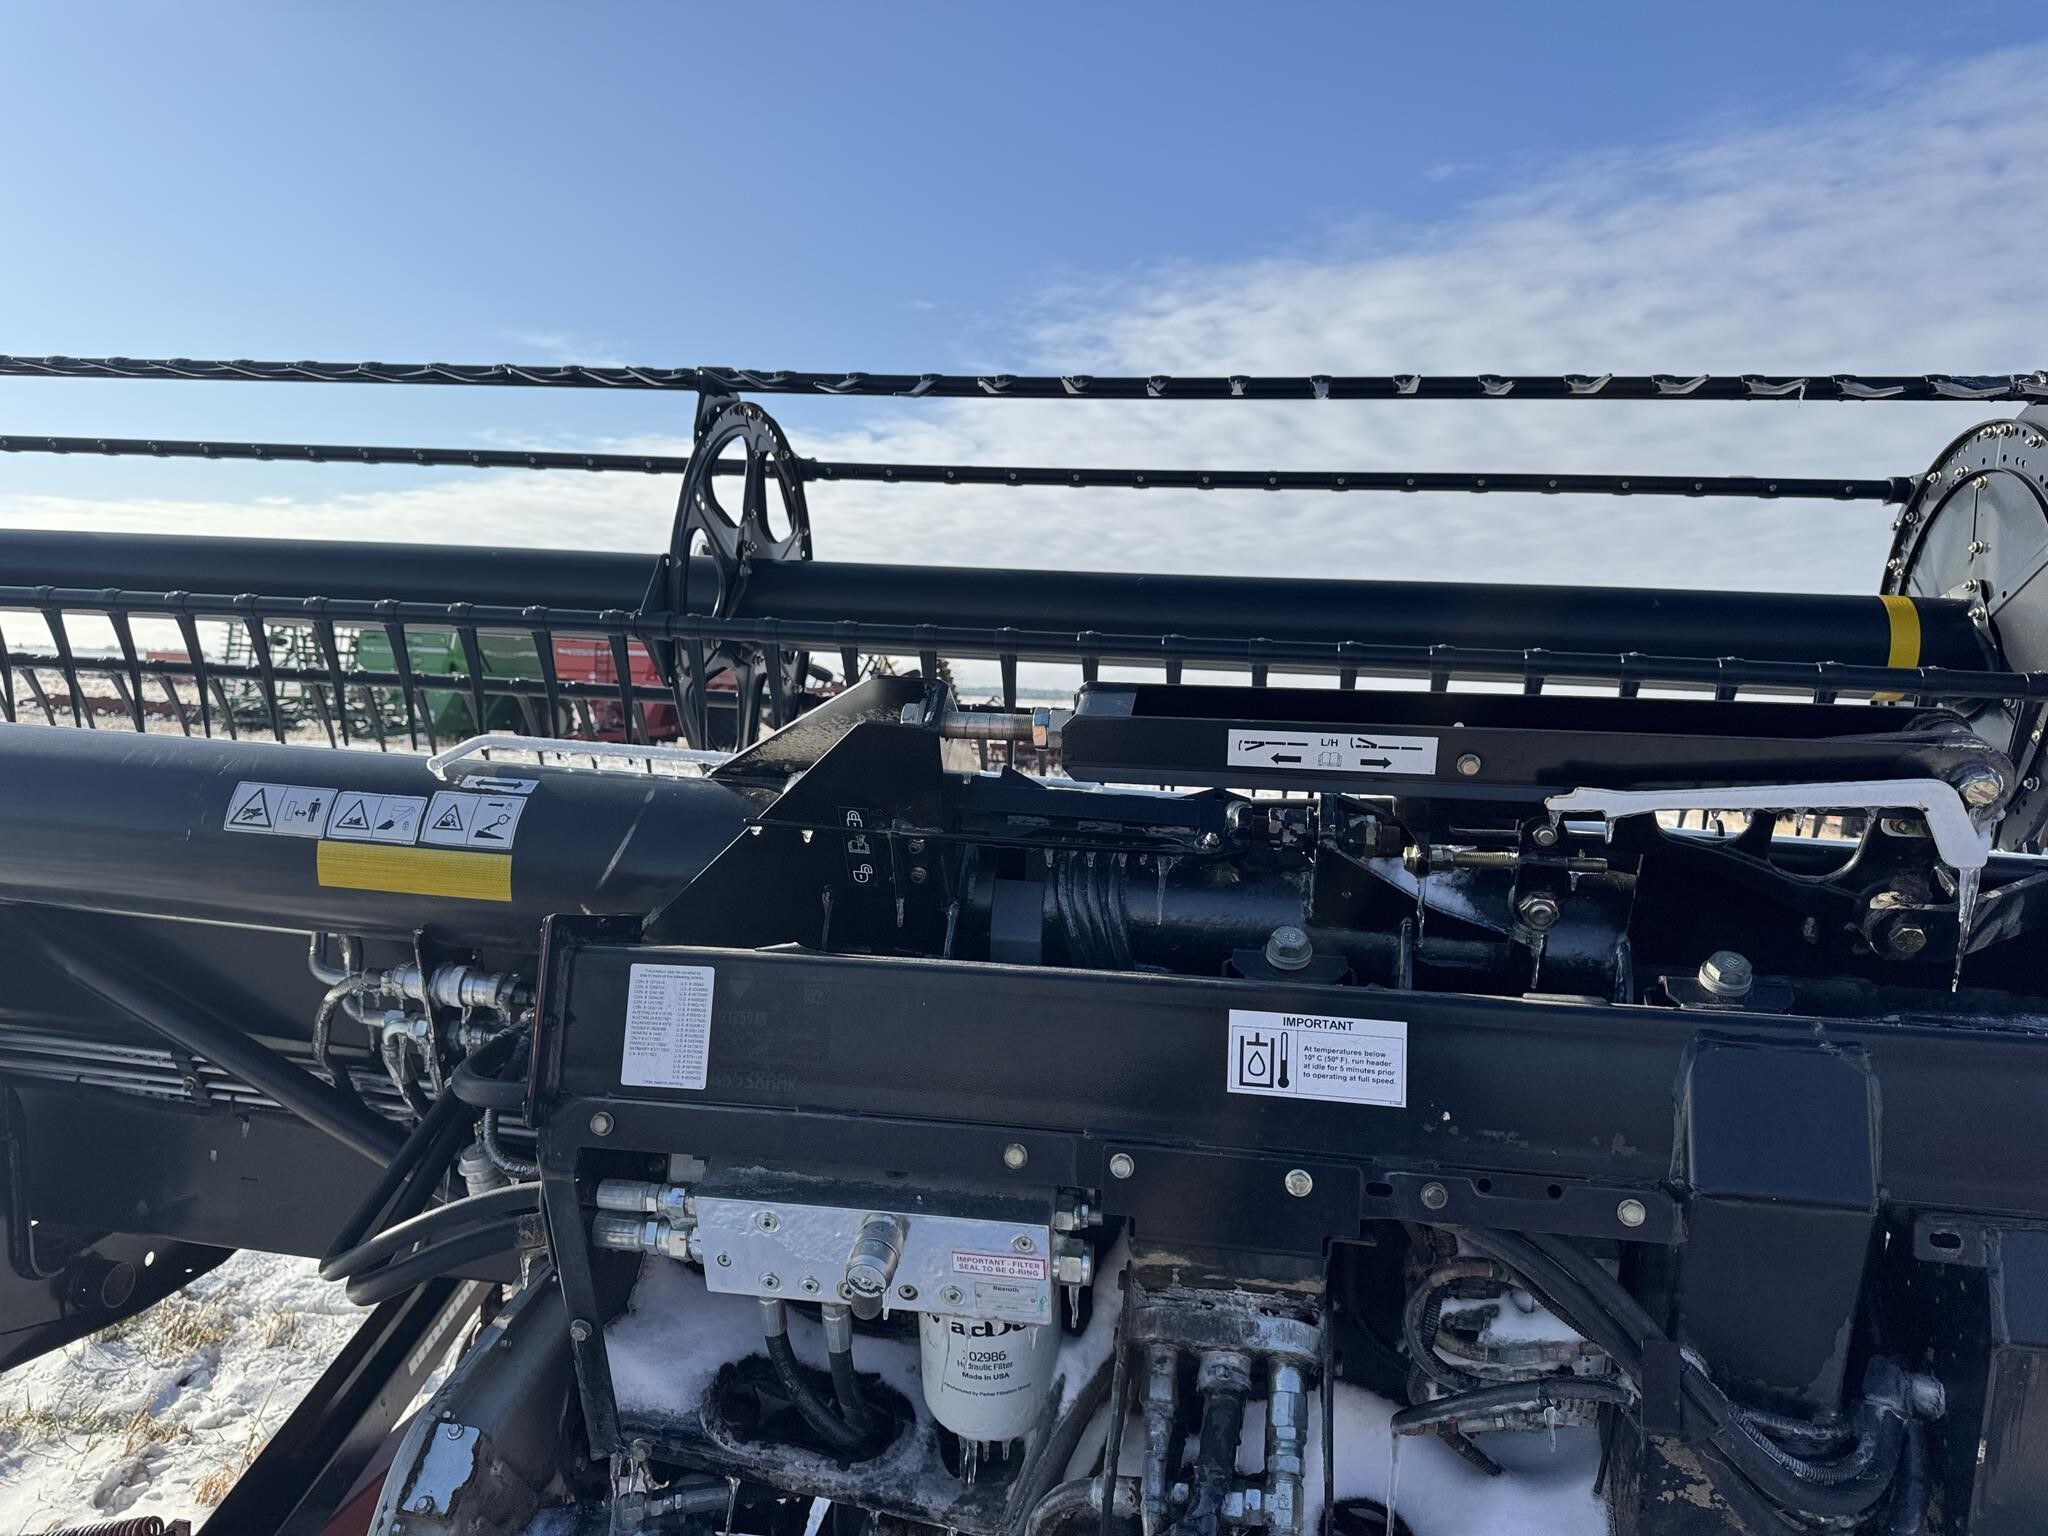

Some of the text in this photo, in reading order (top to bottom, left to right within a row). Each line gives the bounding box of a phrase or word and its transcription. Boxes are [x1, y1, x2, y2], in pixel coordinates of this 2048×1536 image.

[1320, 738, 1338, 747] L/H
[1283, 1017, 1354, 1031] IMPORTANT
[1314, 1046, 1361, 1056] temperatures
[1346, 1066, 1376, 1075] minutes
[1312, 1073, 1347, 1082] operating
[957, 1256, 1005, 1266] IMPORTANT
[1009, 1268, 1039, 1276] O-RING
[969, 1350, 1006, 1362] 02986
[994, 1361, 1013, 1370] Filter
[962, 1372, 982, 1380] Made
